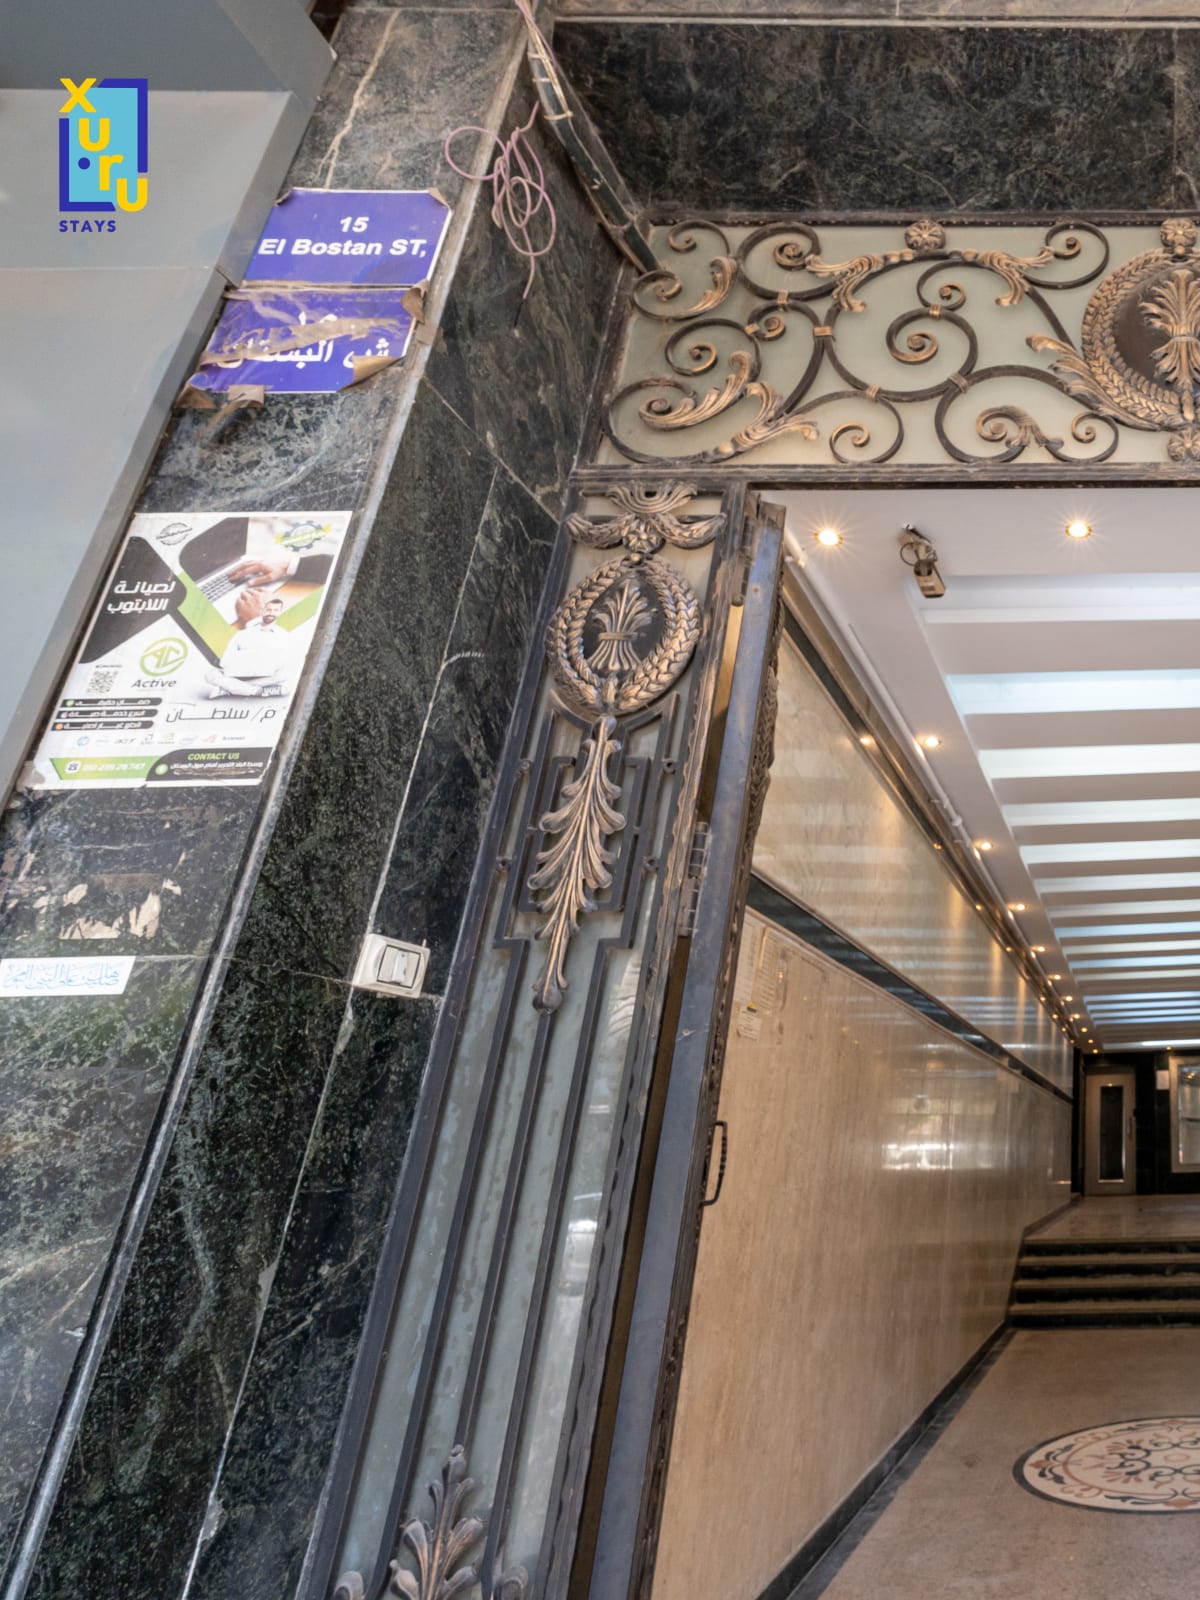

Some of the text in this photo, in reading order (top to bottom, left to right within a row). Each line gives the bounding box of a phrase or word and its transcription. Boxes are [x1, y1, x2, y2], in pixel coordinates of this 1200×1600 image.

[340, 216, 369, 233] 15
[257, 238, 287, 255] El
[291, 238, 383, 255] Bostan
[113, 580, 177, 596] لصيانة
[107, 598, 169, 614] اللابتوب
[131, 679, 177, 689] Active
[187, 752, 226, 761] CONTACT
